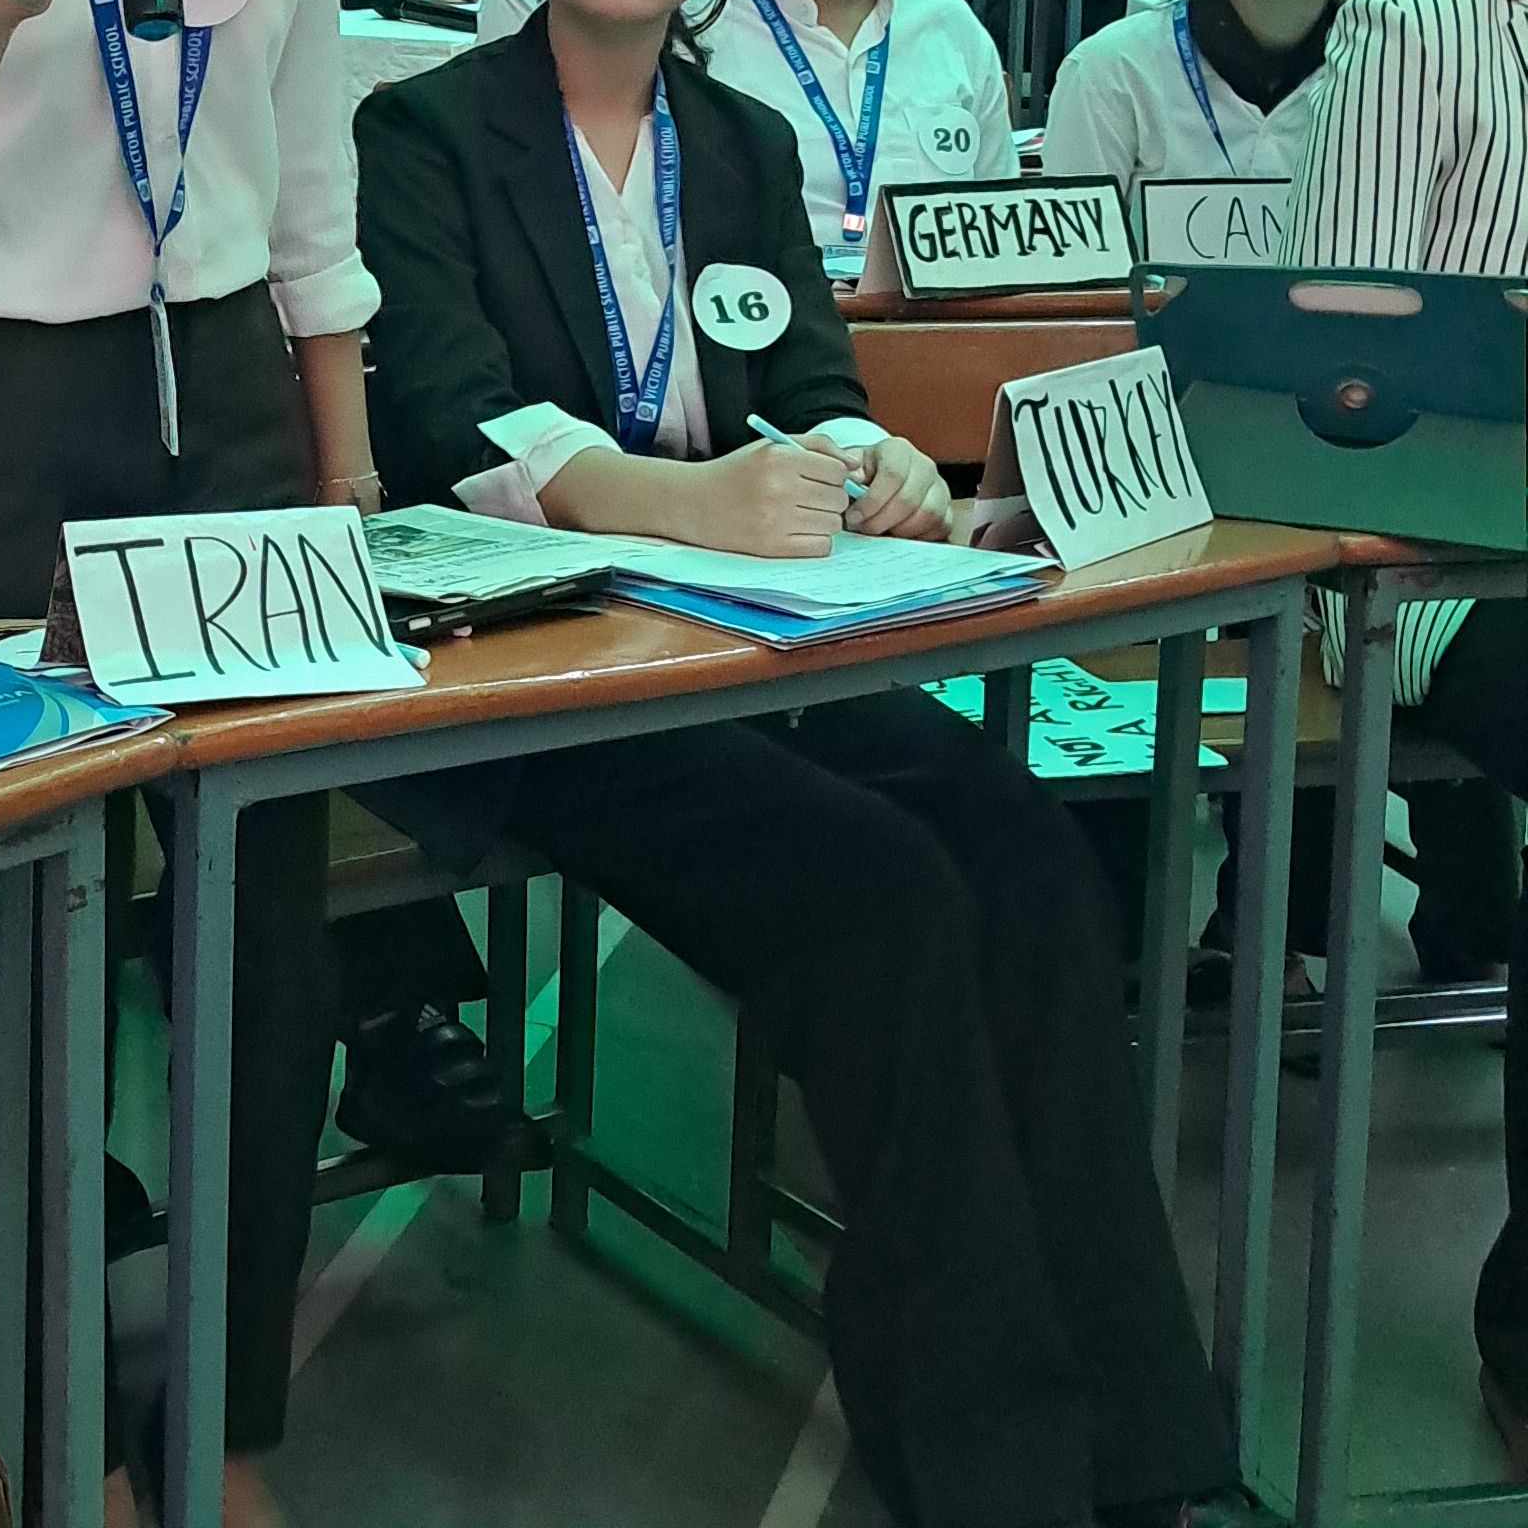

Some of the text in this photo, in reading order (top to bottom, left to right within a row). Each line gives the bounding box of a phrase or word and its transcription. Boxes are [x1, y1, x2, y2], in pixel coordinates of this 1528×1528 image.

[184, 28, 204, 82] SCHOOL
[105, 22, 145, 177] VICTOR PUBLIC SCHOOL
[932, 126, 971, 152] 20
[908, 197, 1111, 262] GERMANY
[604, 305, 625, 348] PUBLIC
[709, 291, 771, 325] 16
[614, 349, 633, 391] VICTOR
[643, 361, 665, 400] VICTOR
[1014, 370, 1193, 532] TURKEY
[74, 523, 393, 686] IRAN
[1043, 735, 1125, 767] NOT
